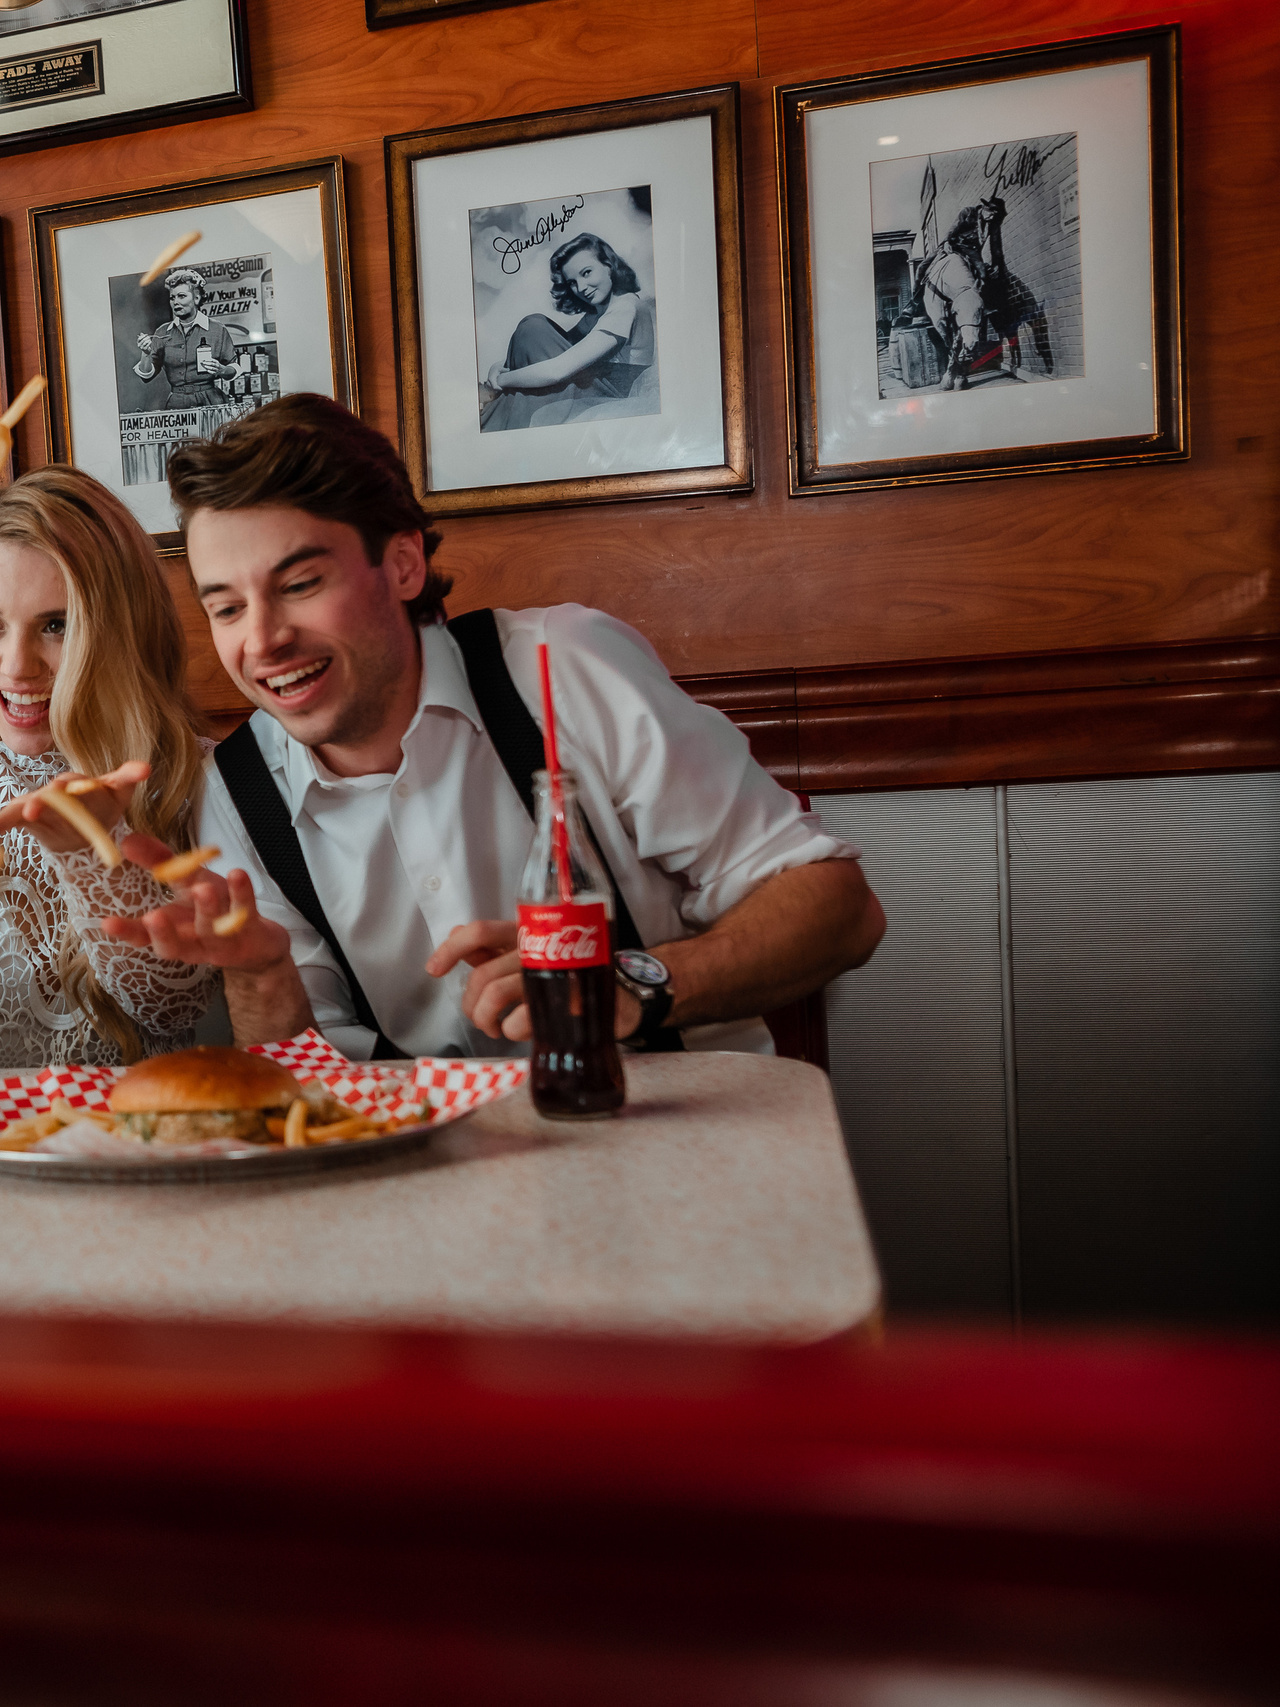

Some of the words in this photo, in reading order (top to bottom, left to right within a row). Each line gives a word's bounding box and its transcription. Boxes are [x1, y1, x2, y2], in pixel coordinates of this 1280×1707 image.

[42, 54, 83, 71] AWAY
[216, 290, 236, 300] Your
[238, 286, 257, 299] Way
[121, 432, 141, 442] FOR
[147, 429, 189, 440] HEALTH
